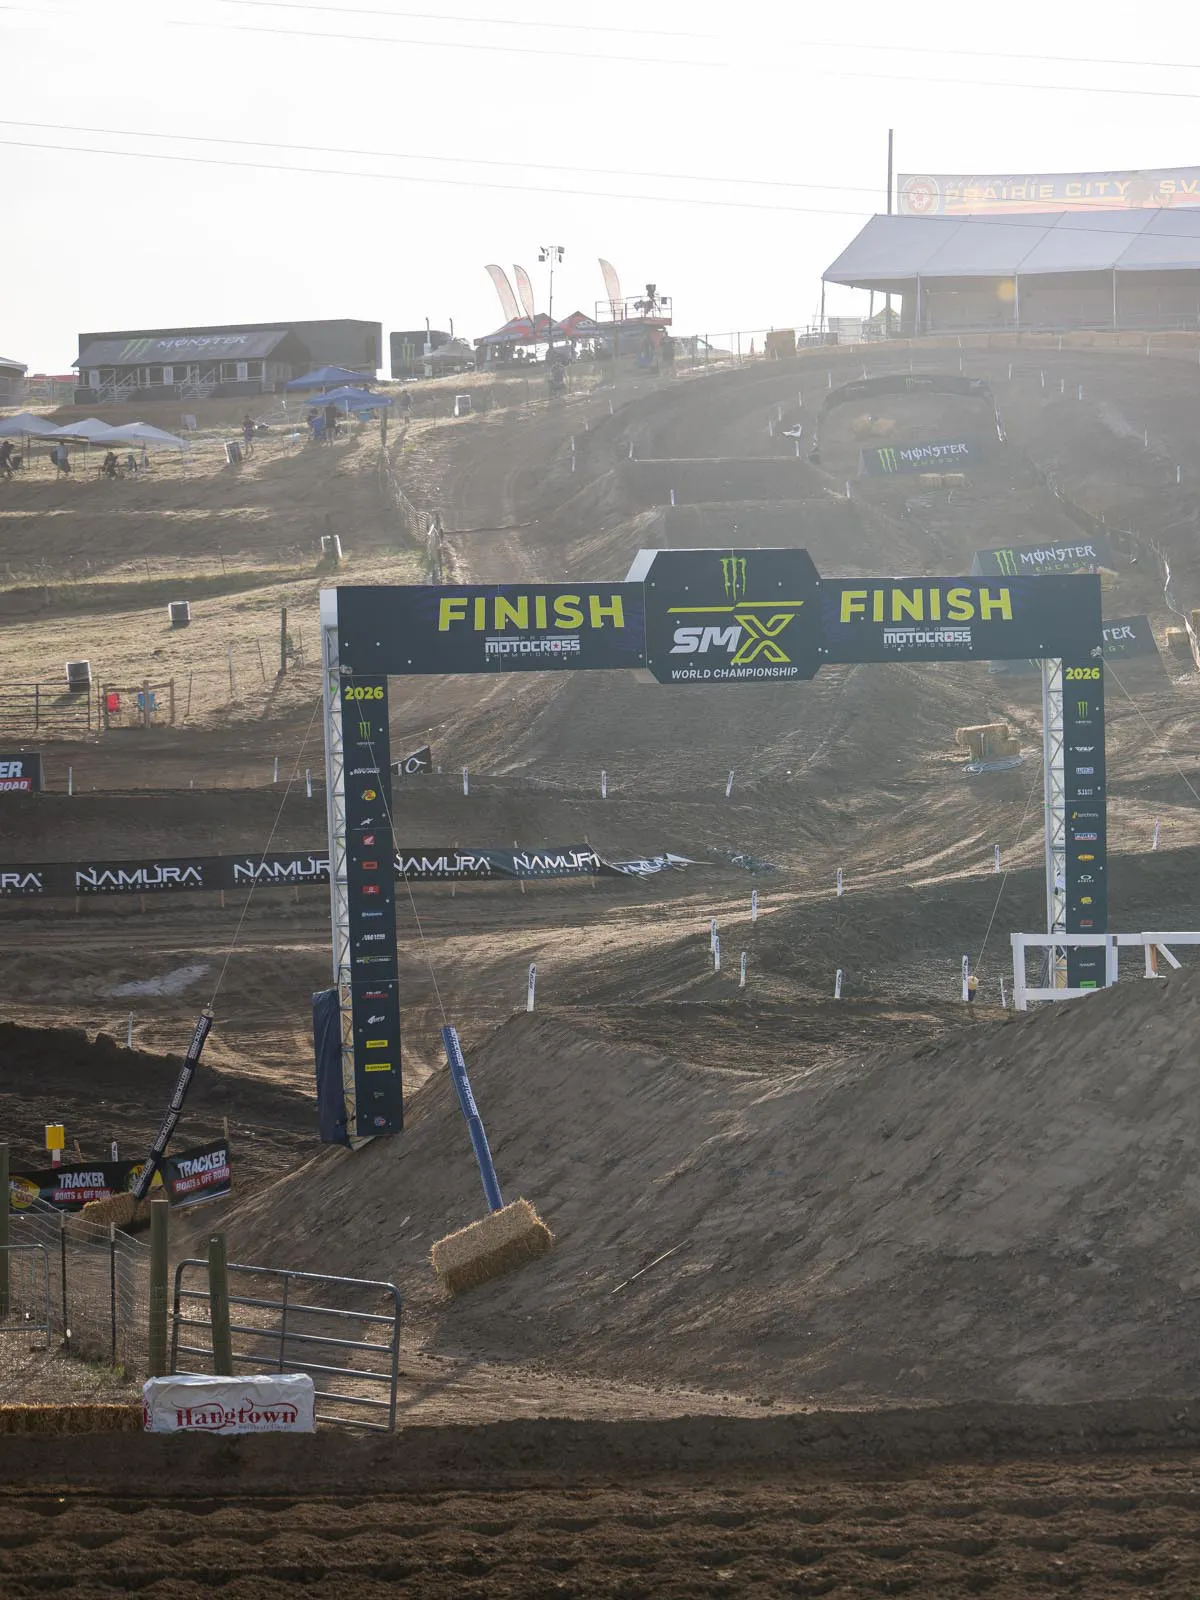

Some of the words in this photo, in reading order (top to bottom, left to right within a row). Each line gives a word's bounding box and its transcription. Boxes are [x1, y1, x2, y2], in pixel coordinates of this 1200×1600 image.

[1065, 179, 1131, 198] CITY
[156, 335, 250, 349] MONSTER
[900, 443, 968, 461] MONSTER
[1020, 545, 1096, 565] MONSTER
[438, 594, 625, 631] FINISH
[840, 587, 1013, 622] FINISH
[485, 639, 581, 653] MOTOCROSS
[669, 613, 796, 664] SMX
[883, 631, 972, 644] MOTOCROSS
[671, 668, 711, 679] WORLD
[713, 667, 798, 678] CHAMPIONSHIP
[1065, 667, 1100, 680] 2026
[344, 686, 384, 700] 2026
[75, 864, 202, 886] NAMURA
[233, 856, 329, 879] NAMUR
[177, 1149, 226, 1179] TRACKER
[58, 1172, 106, 1189] TRACKER
[175, 1178, 196, 1191] BOATS
[201, 1173, 213, 1185] OFF
[213, 1167, 230, 1180] ROAD
[55, 1191, 75, 1201] BOATS
[83, 1190, 95, 1200] OFF
[175, 1402, 298, 1429] Hangtown
